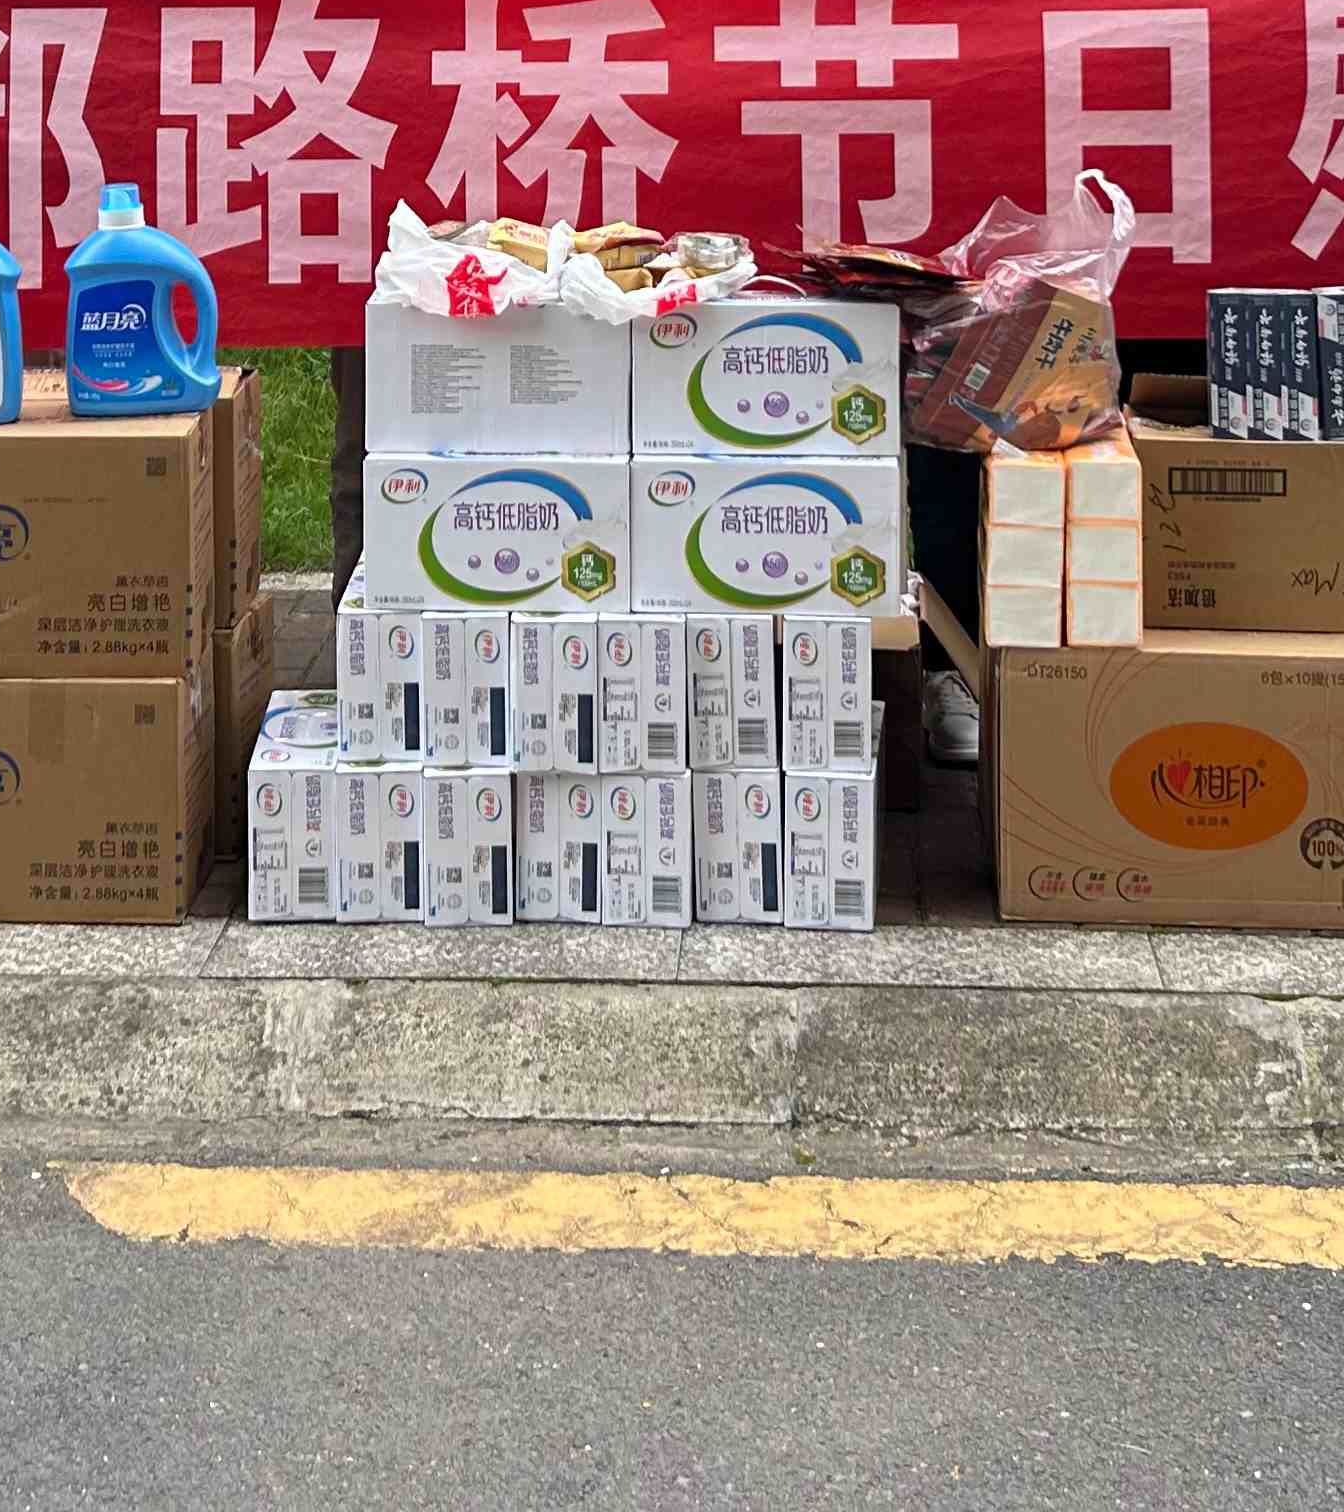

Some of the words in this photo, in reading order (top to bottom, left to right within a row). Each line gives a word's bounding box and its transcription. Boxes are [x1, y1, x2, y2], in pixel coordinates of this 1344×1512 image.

[81, 303, 147, 331] 蓝月亮
[656, 321, 689, 338] 伊利
[723, 345, 829, 375] 高钙低脂奶
[387, 478, 420, 494] 伊利
[655, 480, 689, 497] 伊利
[453, 502, 559, 531] 高钙低脂奶
[721, 505, 828, 534] 高钙低脂奶
[88, 593, 171, 612] 亮白增艳
[1150, 759, 1264, 809] 心相印
[78, 839, 160, 859] 亮白增艳
[1311, 840, 1344, 857] 100%
